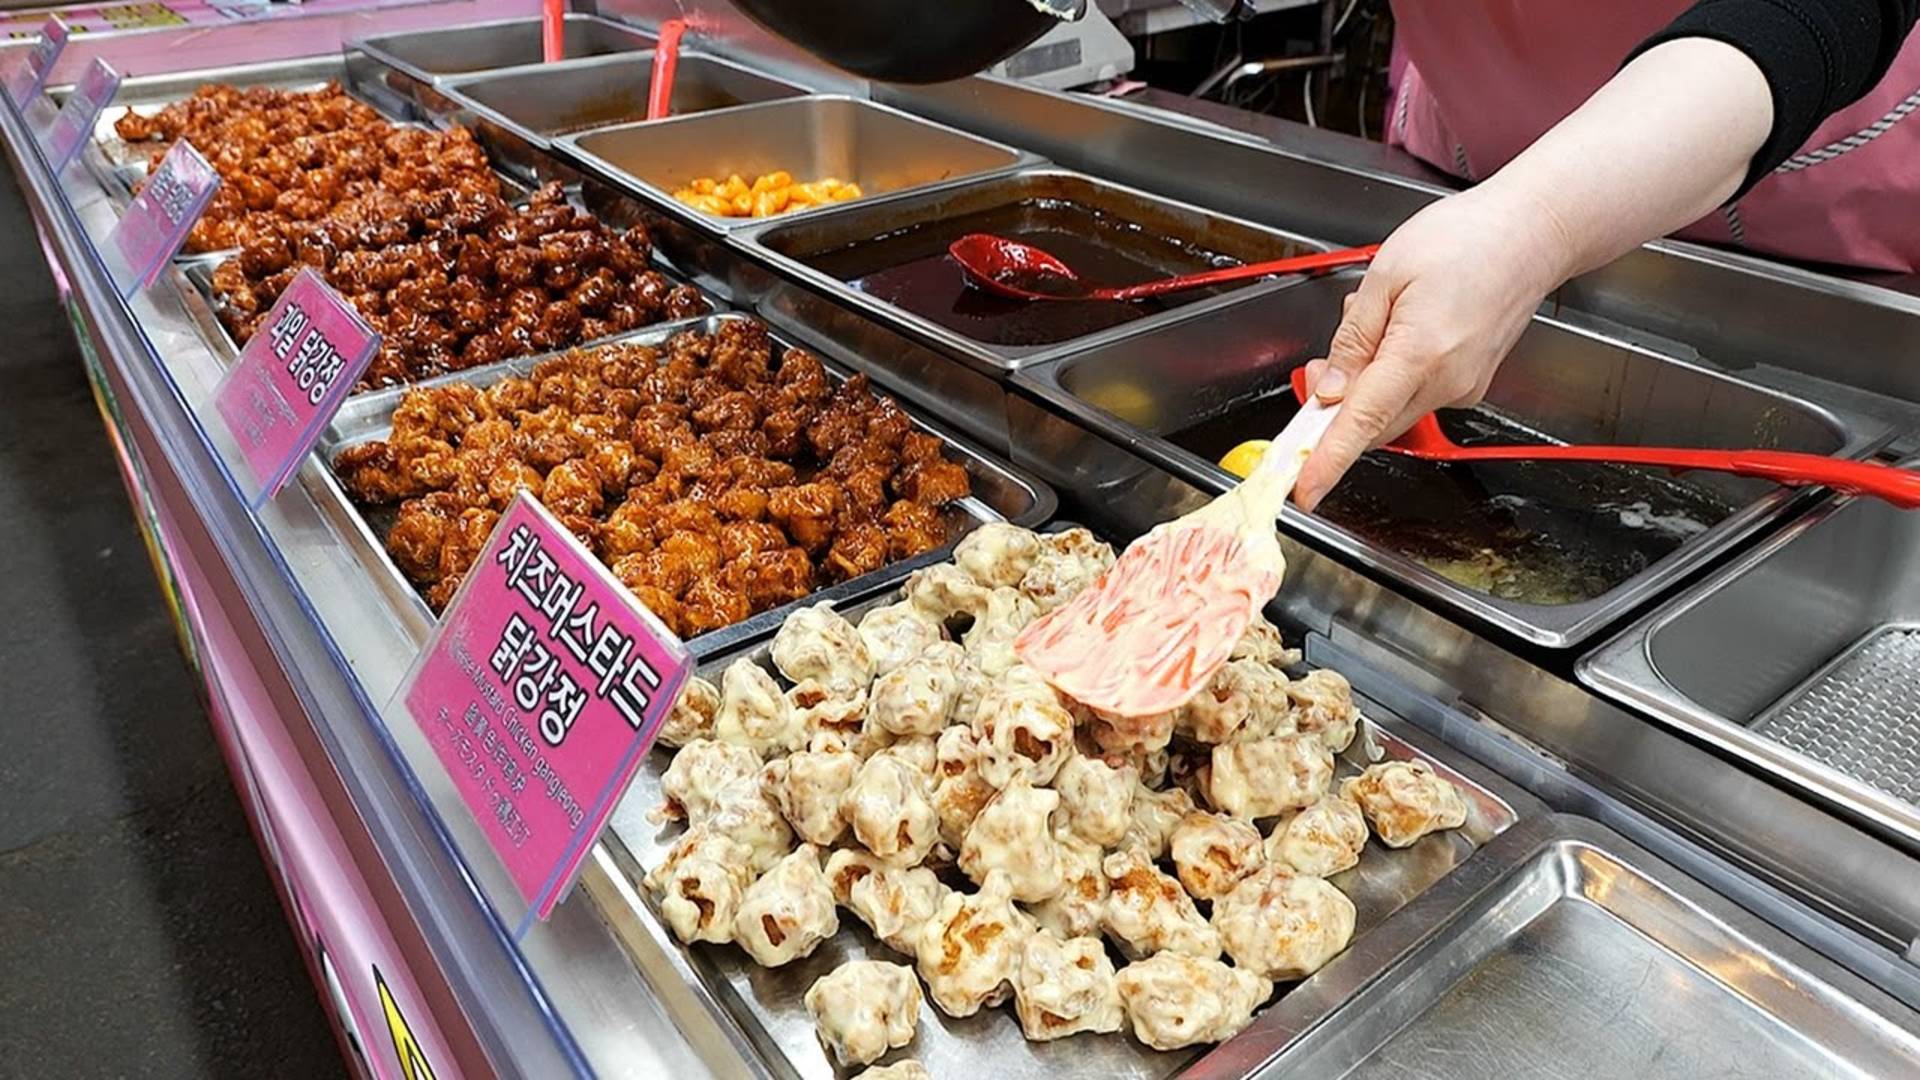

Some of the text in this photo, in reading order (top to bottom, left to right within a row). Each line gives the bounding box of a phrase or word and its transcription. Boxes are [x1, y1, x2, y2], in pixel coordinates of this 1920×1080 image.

[268, 303, 310, 361] 과일
[287, 326, 347, 406] 닭강정
[489, 615, 589, 746] 닭강정
[495, 524, 662, 729] 치즈머스타드
[502, 708, 538, 764] Chicken
[531, 755, 585, 829] gangjeong
